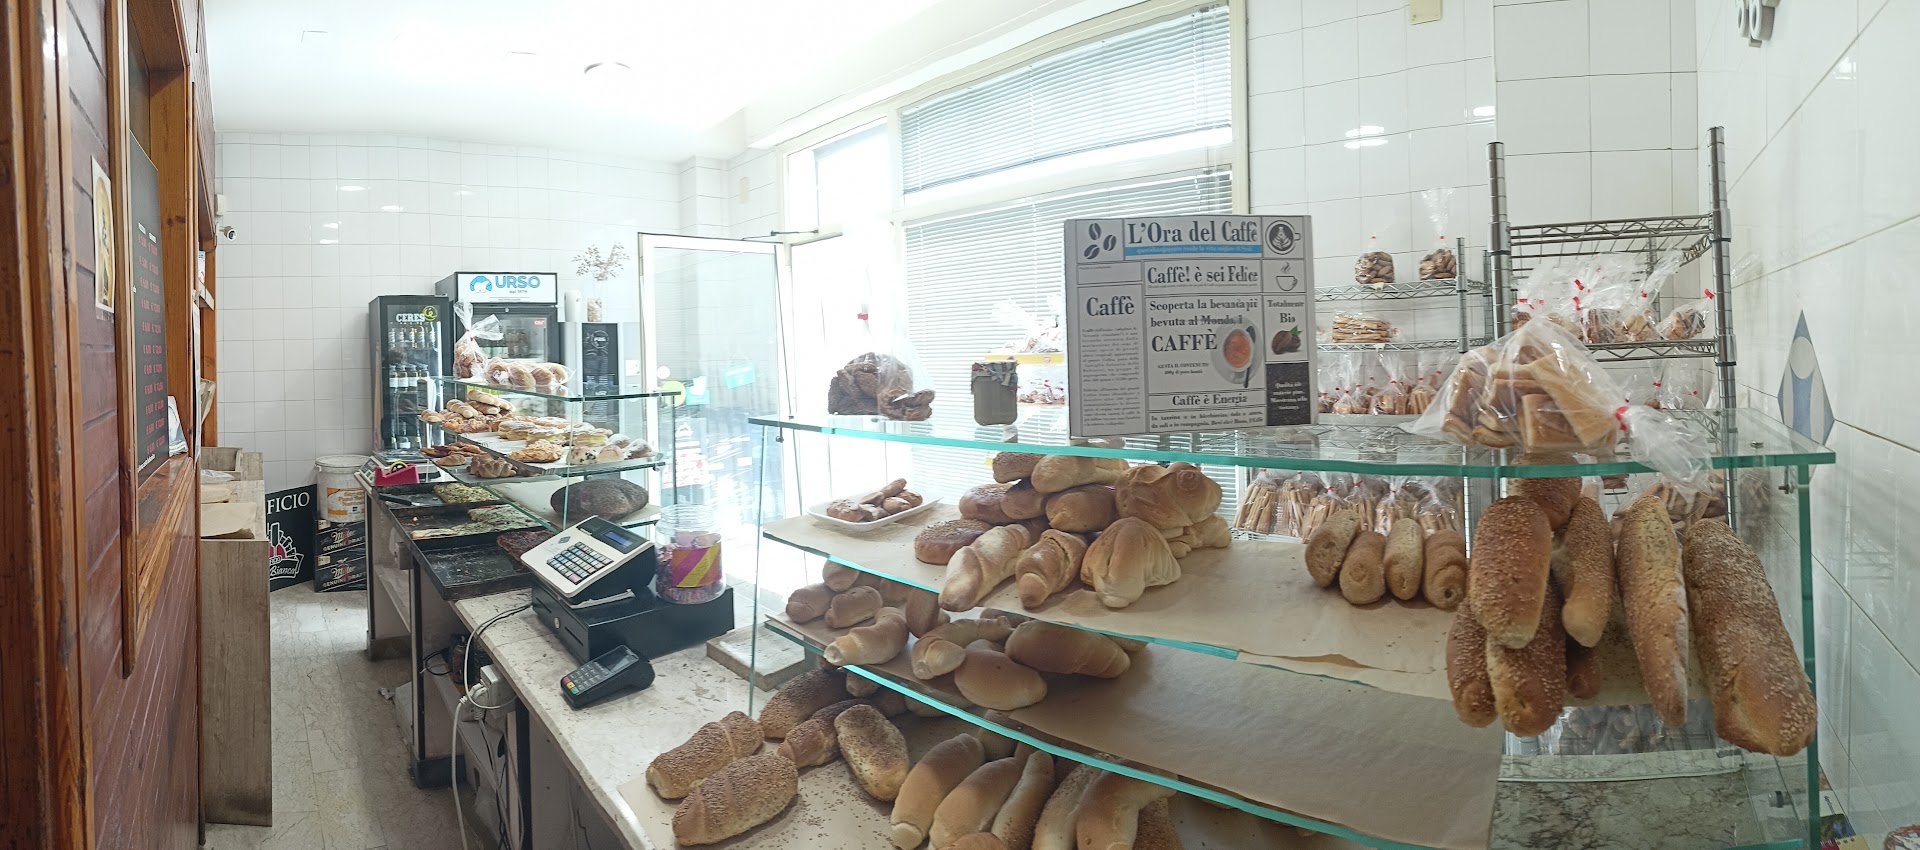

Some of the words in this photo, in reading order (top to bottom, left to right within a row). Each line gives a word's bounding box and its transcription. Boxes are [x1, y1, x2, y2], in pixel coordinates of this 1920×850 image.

[1127, 221, 1183, 245] L'Ora
[1189, 220, 1216, 242] del
[1222, 220, 1258, 243] Caffè
[495, 275, 541, 289] URSO
[1147, 266, 1190, 284] Caffè!
[1195, 267, 1203, 282] è
[1206, 266, 1224, 283] sei
[1086, 295, 1135, 316] Caffè
[1149, 300, 1195, 313] Scoperta
[1197, 299, 1207, 309] la
[396, 313, 425, 322] CERES
[1150, 317, 1186, 327] bevuta
[1188, 316, 1198, 326] al
[1279, 313, 1296, 323] Bio
[1151, 329, 1218, 352] CAFFÈ
[1172, 394, 1201, 406] Caffè
[1204, 395, 1210, 404] è
[1213, 393, 1248, 407] Energia
[331, 529, 357, 542] Miller
[331, 565, 357, 578] Miller
